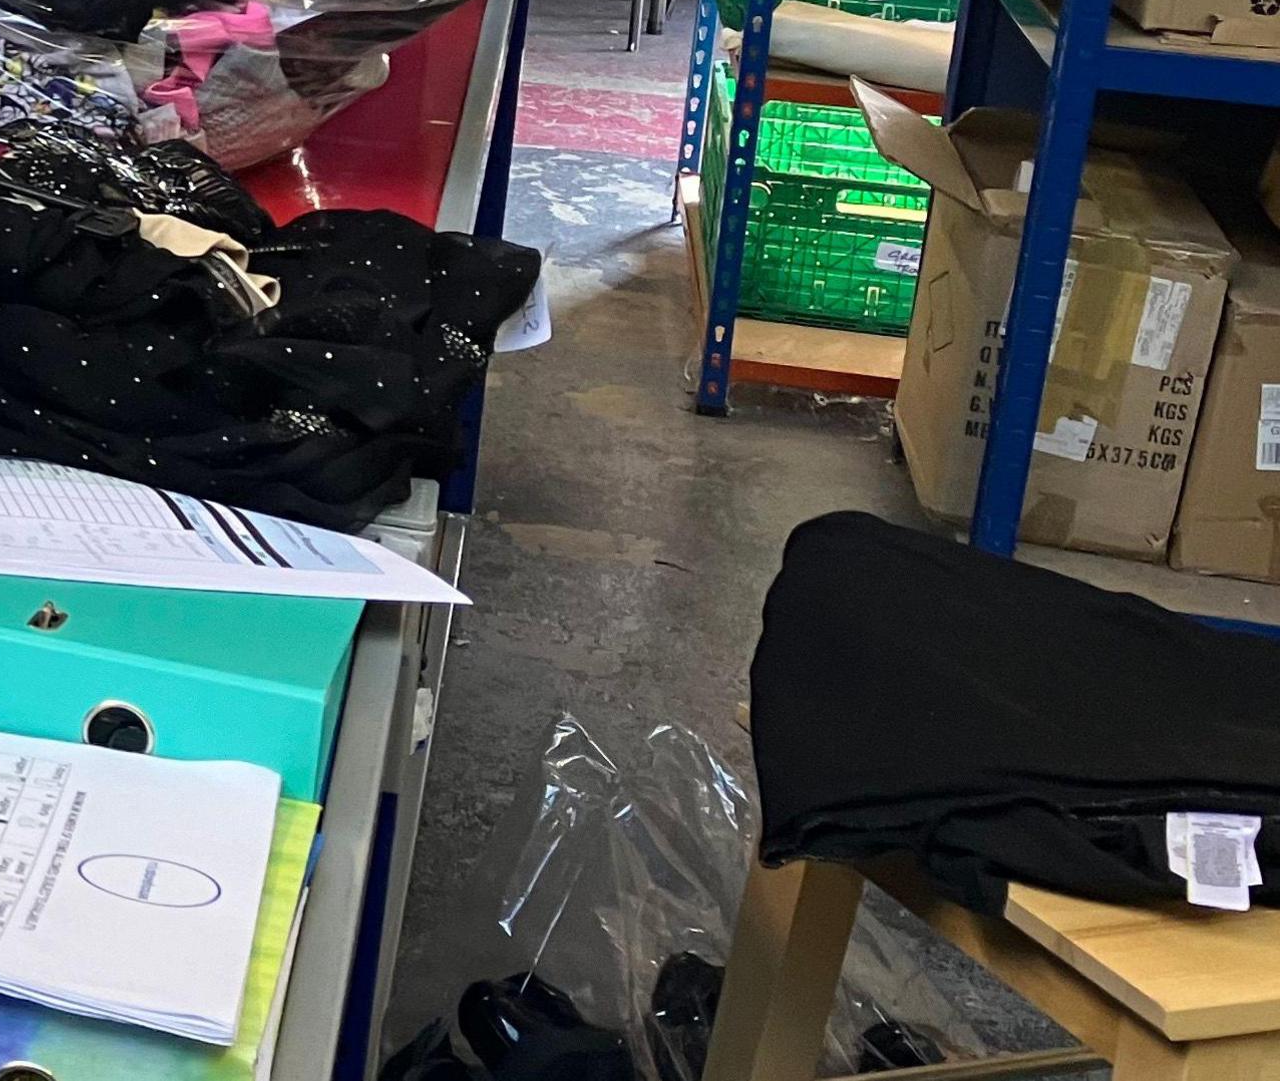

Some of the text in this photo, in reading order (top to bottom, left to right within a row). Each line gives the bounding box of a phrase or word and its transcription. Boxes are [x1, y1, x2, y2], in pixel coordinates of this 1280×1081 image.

[1158, 373, 1195, 396] PCS
[1153, 400, 1189, 422] KGS
[1147, 424, 1184, 447] KGS
